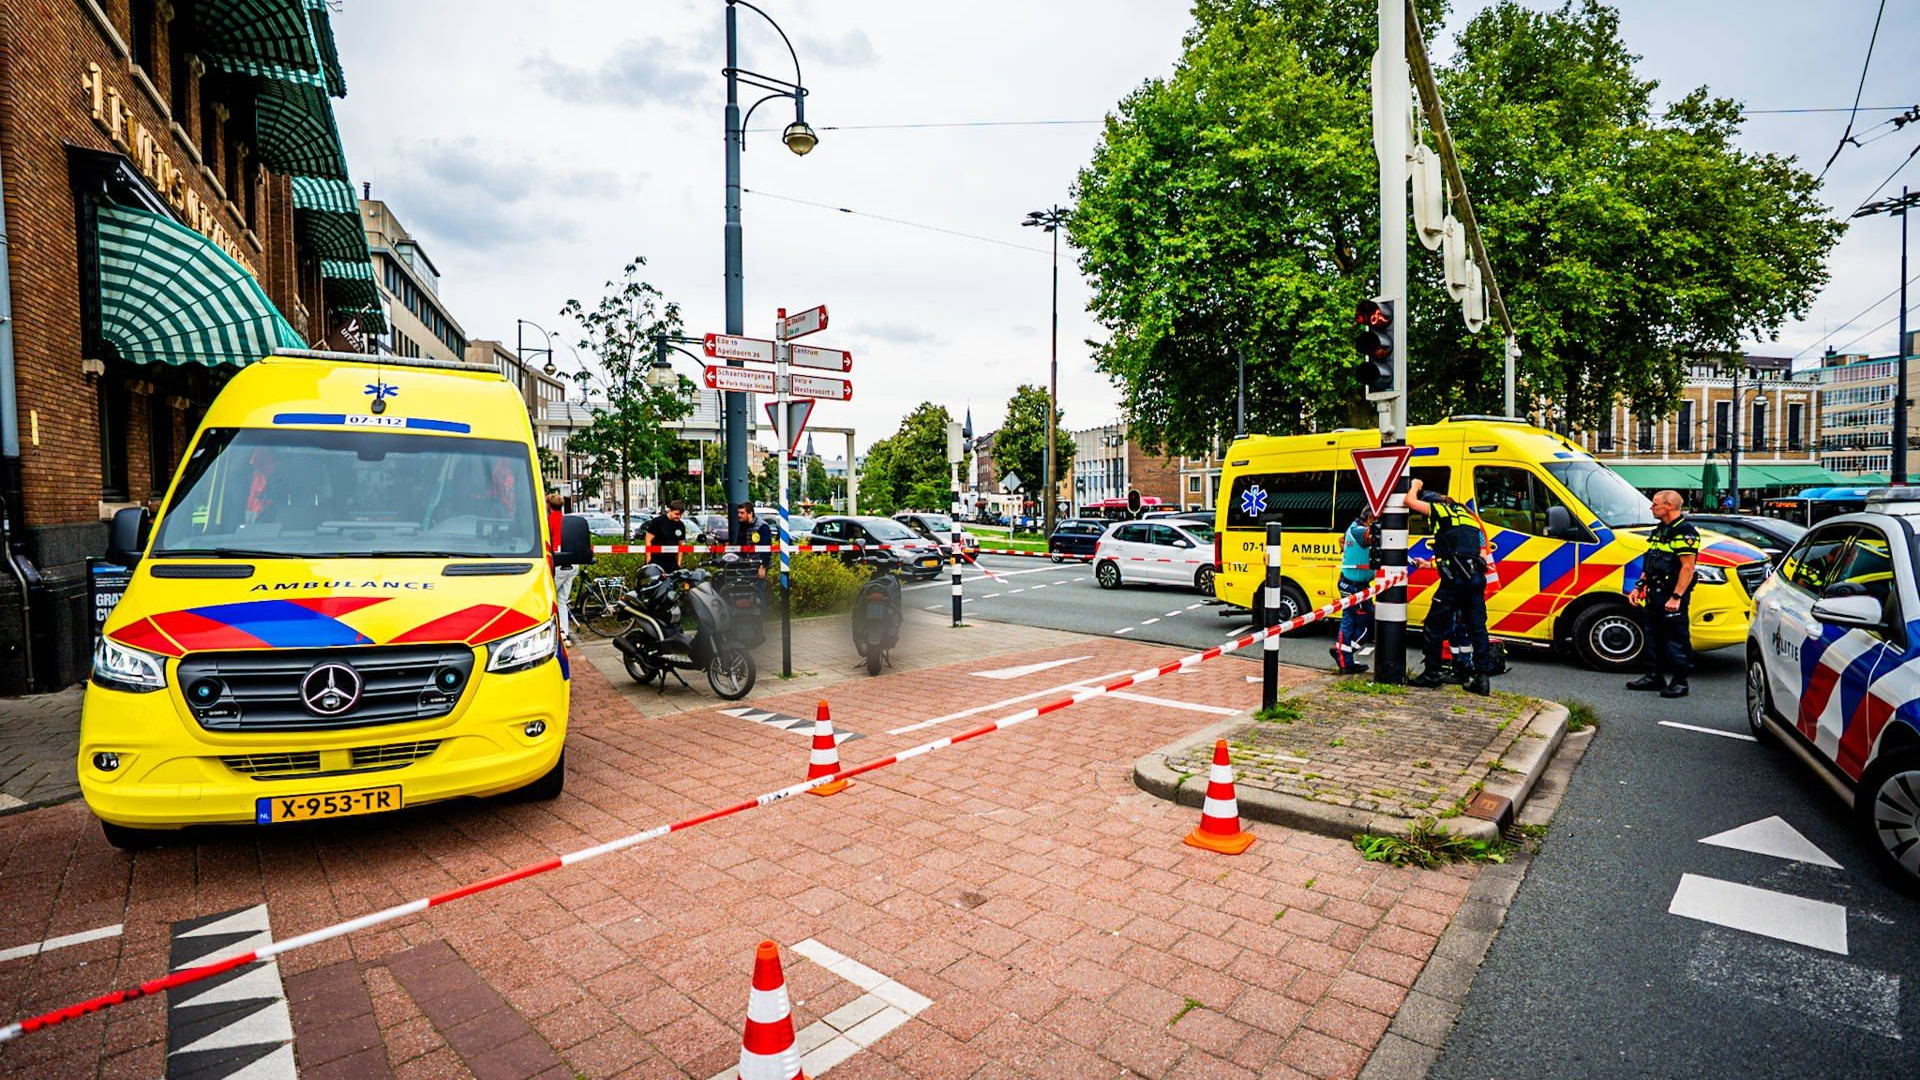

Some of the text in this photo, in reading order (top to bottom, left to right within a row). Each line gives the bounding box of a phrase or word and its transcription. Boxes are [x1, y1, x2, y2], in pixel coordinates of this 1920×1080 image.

[717, 347, 751, 357] Apeldoorn
[793, 346, 819, 356] Centrum
[717, 369, 766, 381] Schaarsbergen
[794, 377, 807, 385] Velp
[794, 387, 830, 396] Westervoort
[349, 416, 402, 425] 07-112
[1242, 541, 1264, 552] 07-1
[250, 581, 435, 592] AMBULANCE
[1771, 631, 1799, 662] POLITIE
[281, 791, 391, 819] X-953-TR
